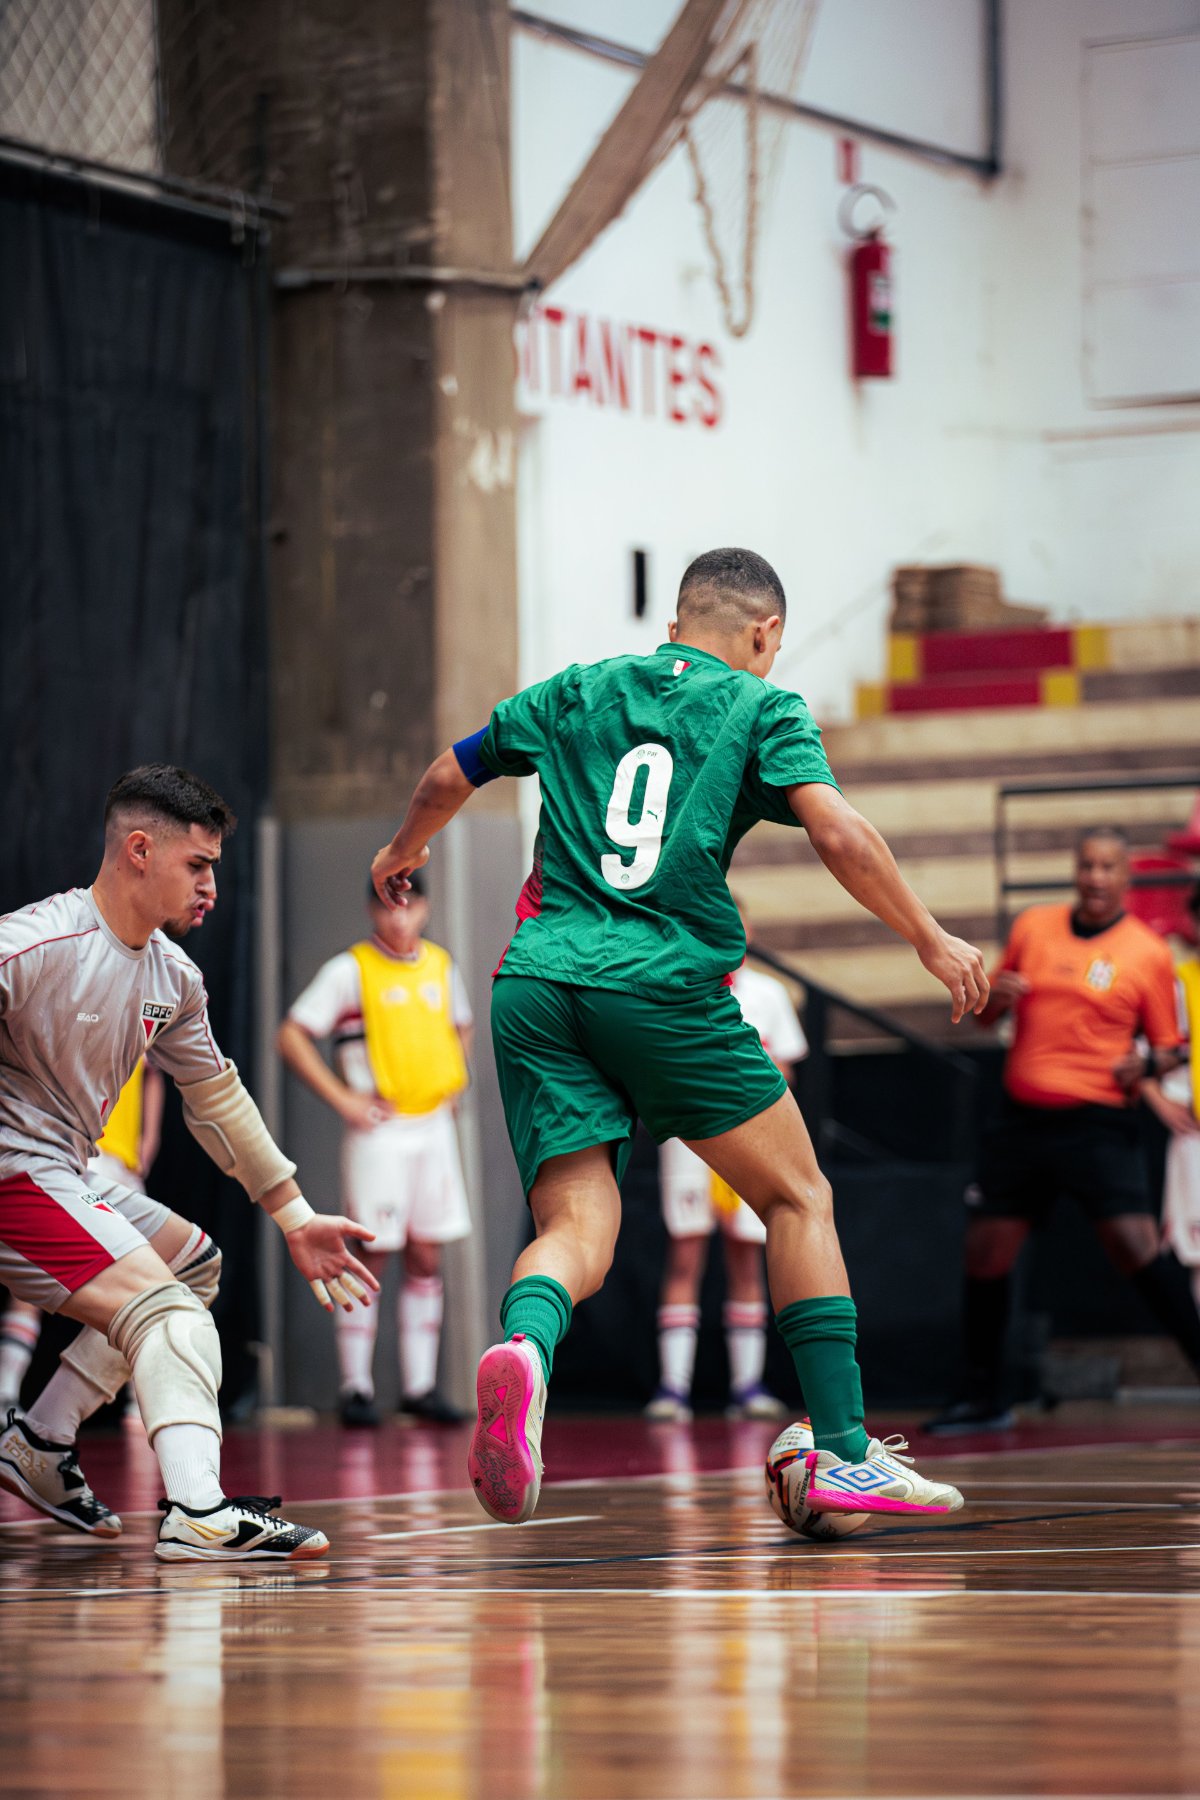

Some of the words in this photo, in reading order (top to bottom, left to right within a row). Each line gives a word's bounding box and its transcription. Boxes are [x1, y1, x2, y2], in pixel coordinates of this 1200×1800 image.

[517, 305, 723, 428] ITANTES
[600, 742, 674, 890] 9
[143, 1004, 173, 1019] SPFC
